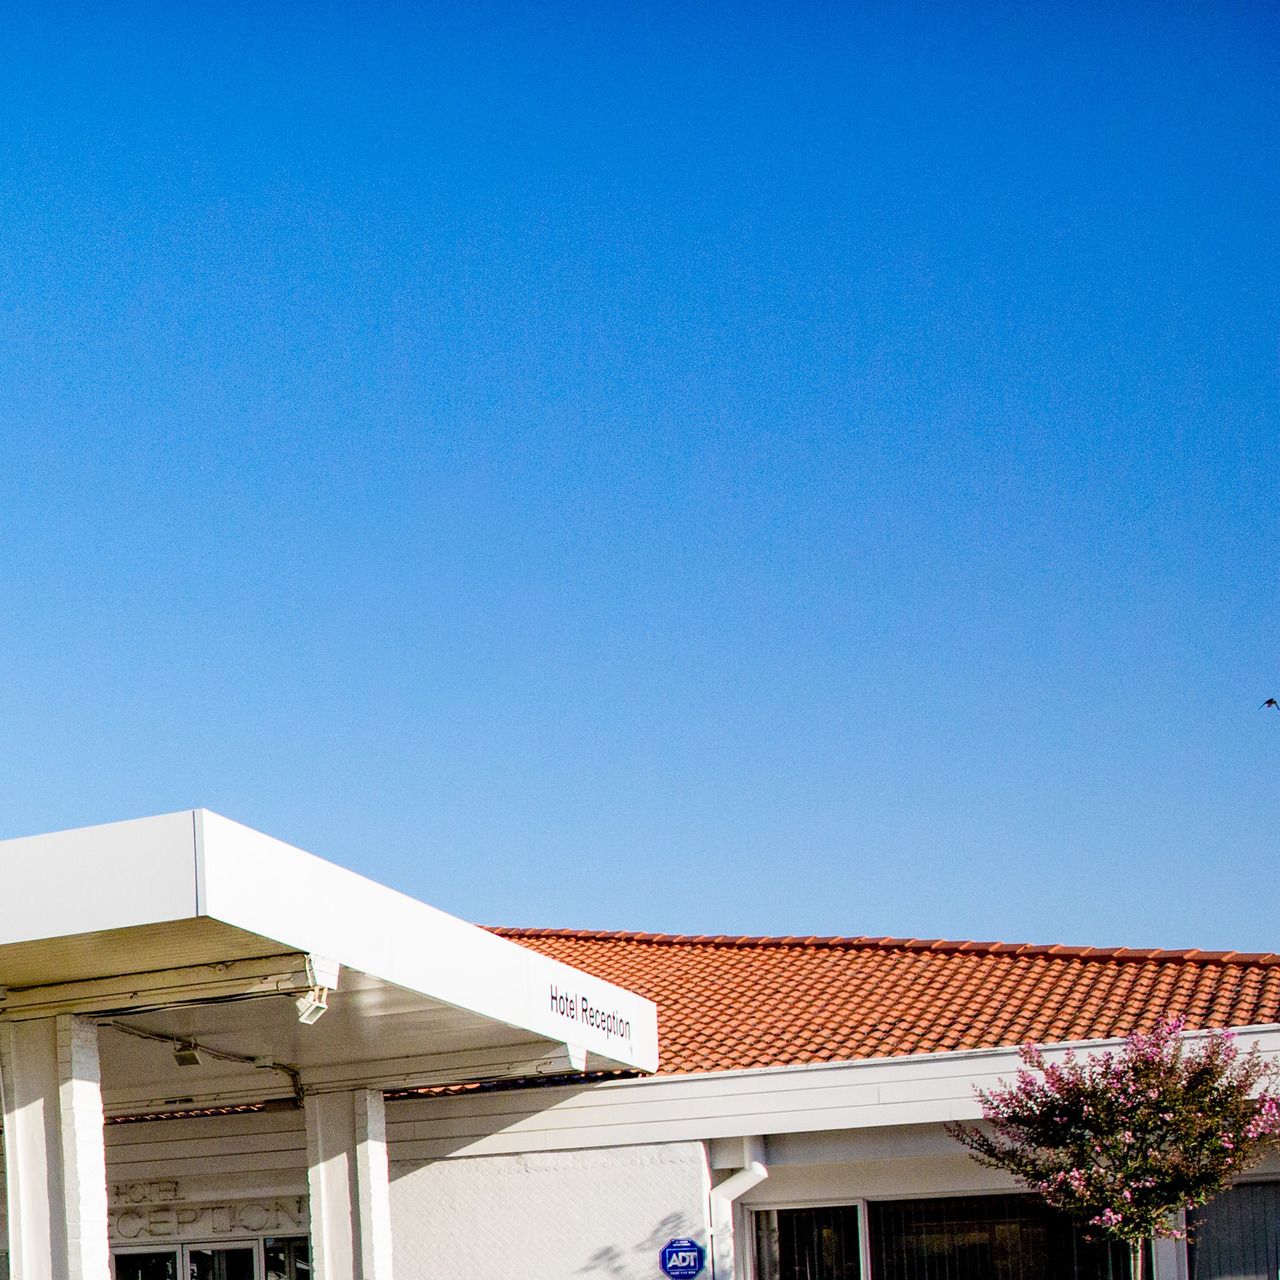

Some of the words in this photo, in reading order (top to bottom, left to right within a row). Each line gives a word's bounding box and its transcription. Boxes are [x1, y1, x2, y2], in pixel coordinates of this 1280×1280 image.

[550, 984, 578, 1021] Hotel
[581, 996, 631, 1040] Reception
[113, 1180, 186, 1205] HOTEL
[109, 1196, 303, 1240] CEPTION
[667, 1251, 698, 1268] ADT
